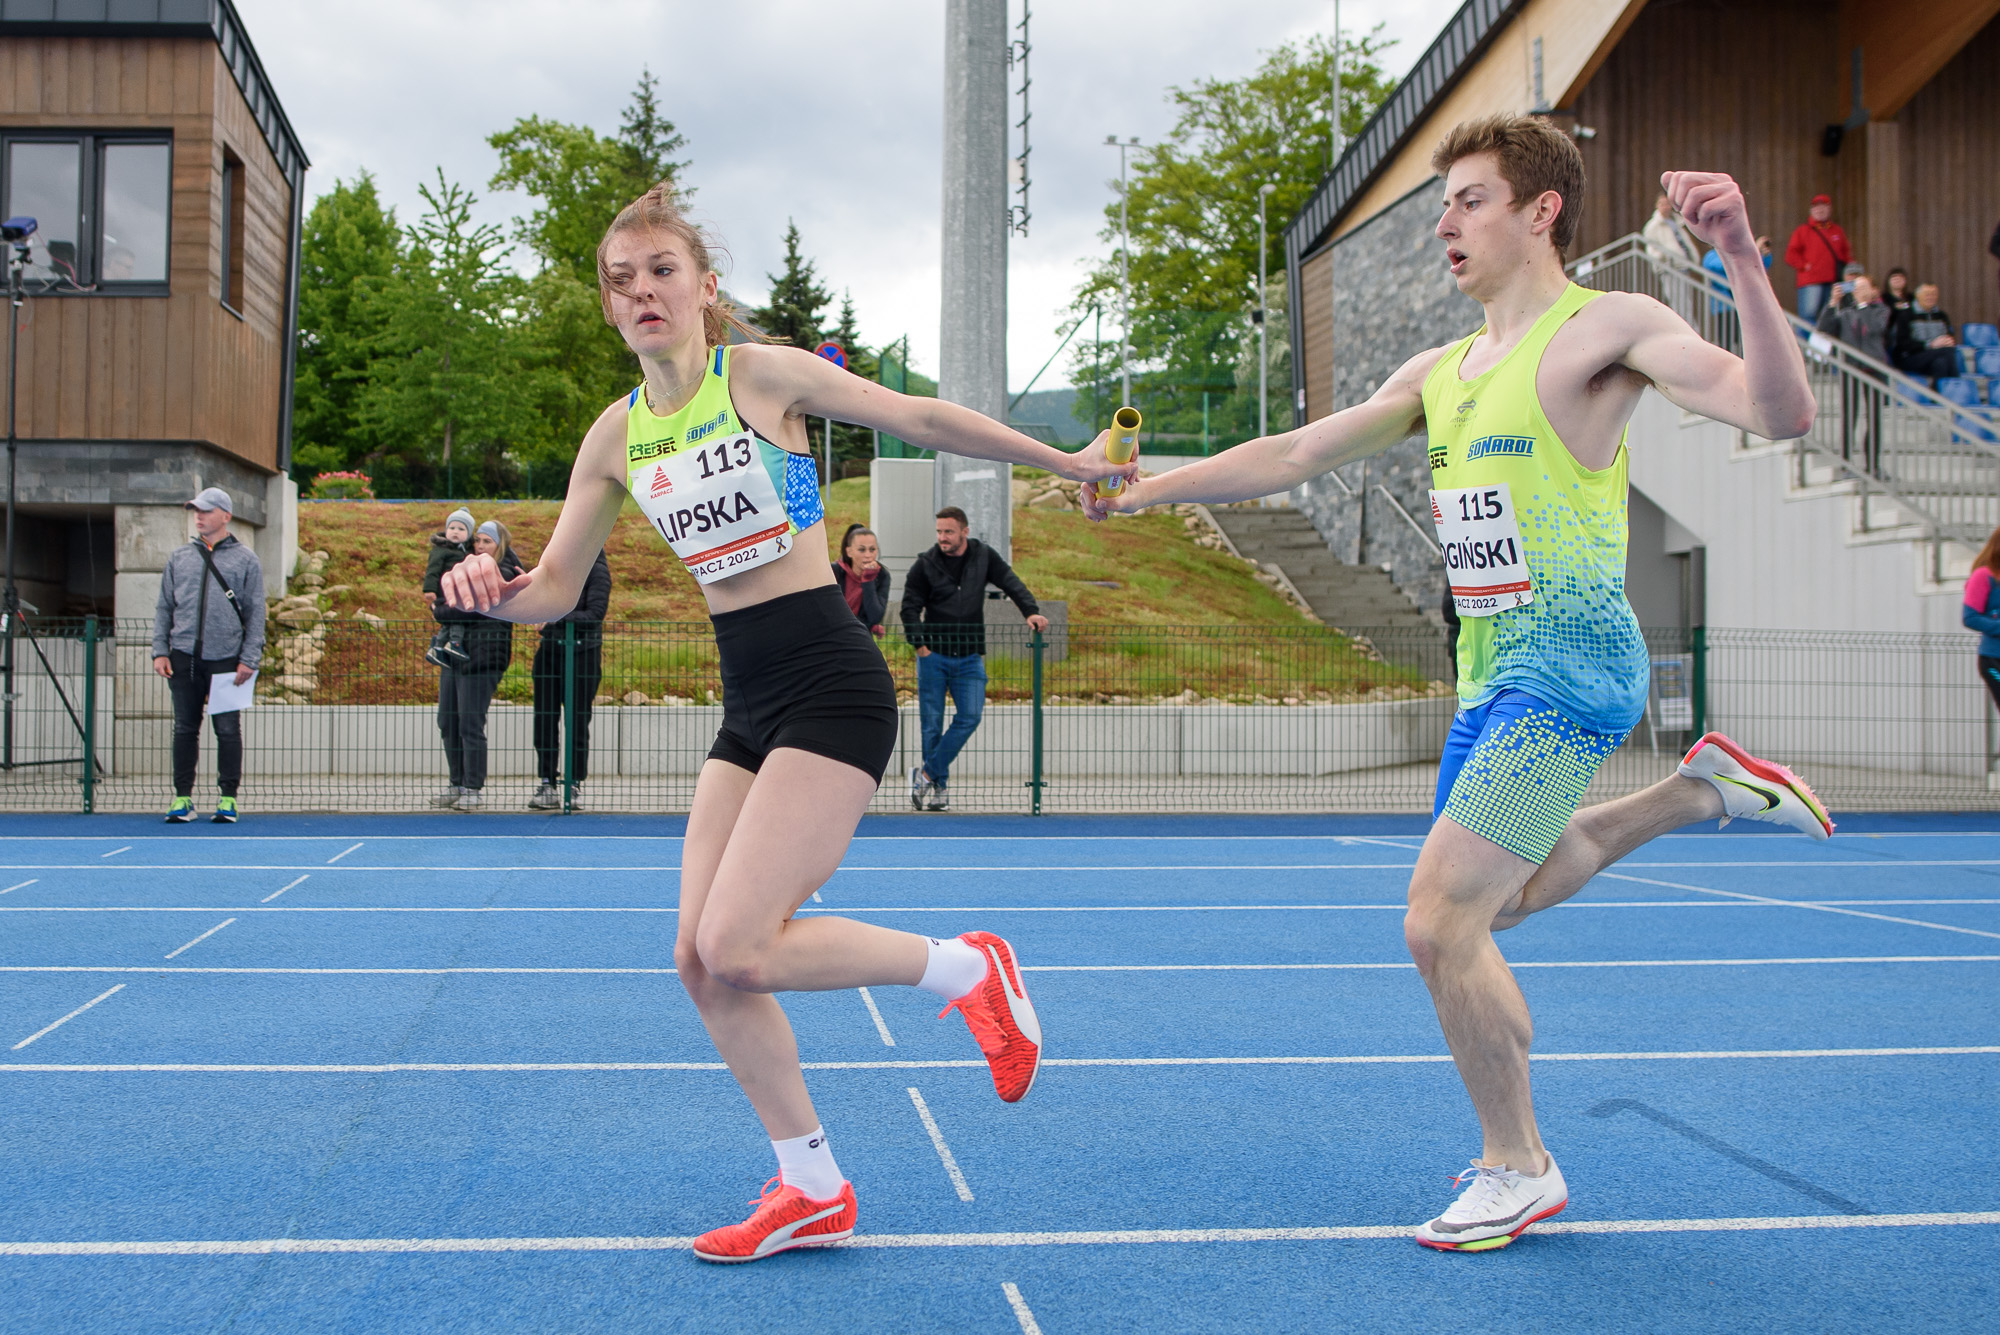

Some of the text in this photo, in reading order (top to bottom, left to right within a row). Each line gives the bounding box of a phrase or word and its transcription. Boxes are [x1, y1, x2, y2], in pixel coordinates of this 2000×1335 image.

[696, 438, 752, 479] 113
[1466, 435, 1535, 461] SONAROL
[650, 488, 674, 499] KARPACZ
[1458, 490, 1503, 521] 115
[657, 491, 759, 543] LIPSKA
[726, 548, 759, 567] 2022
[1471, 597, 1498, 609] 2022
